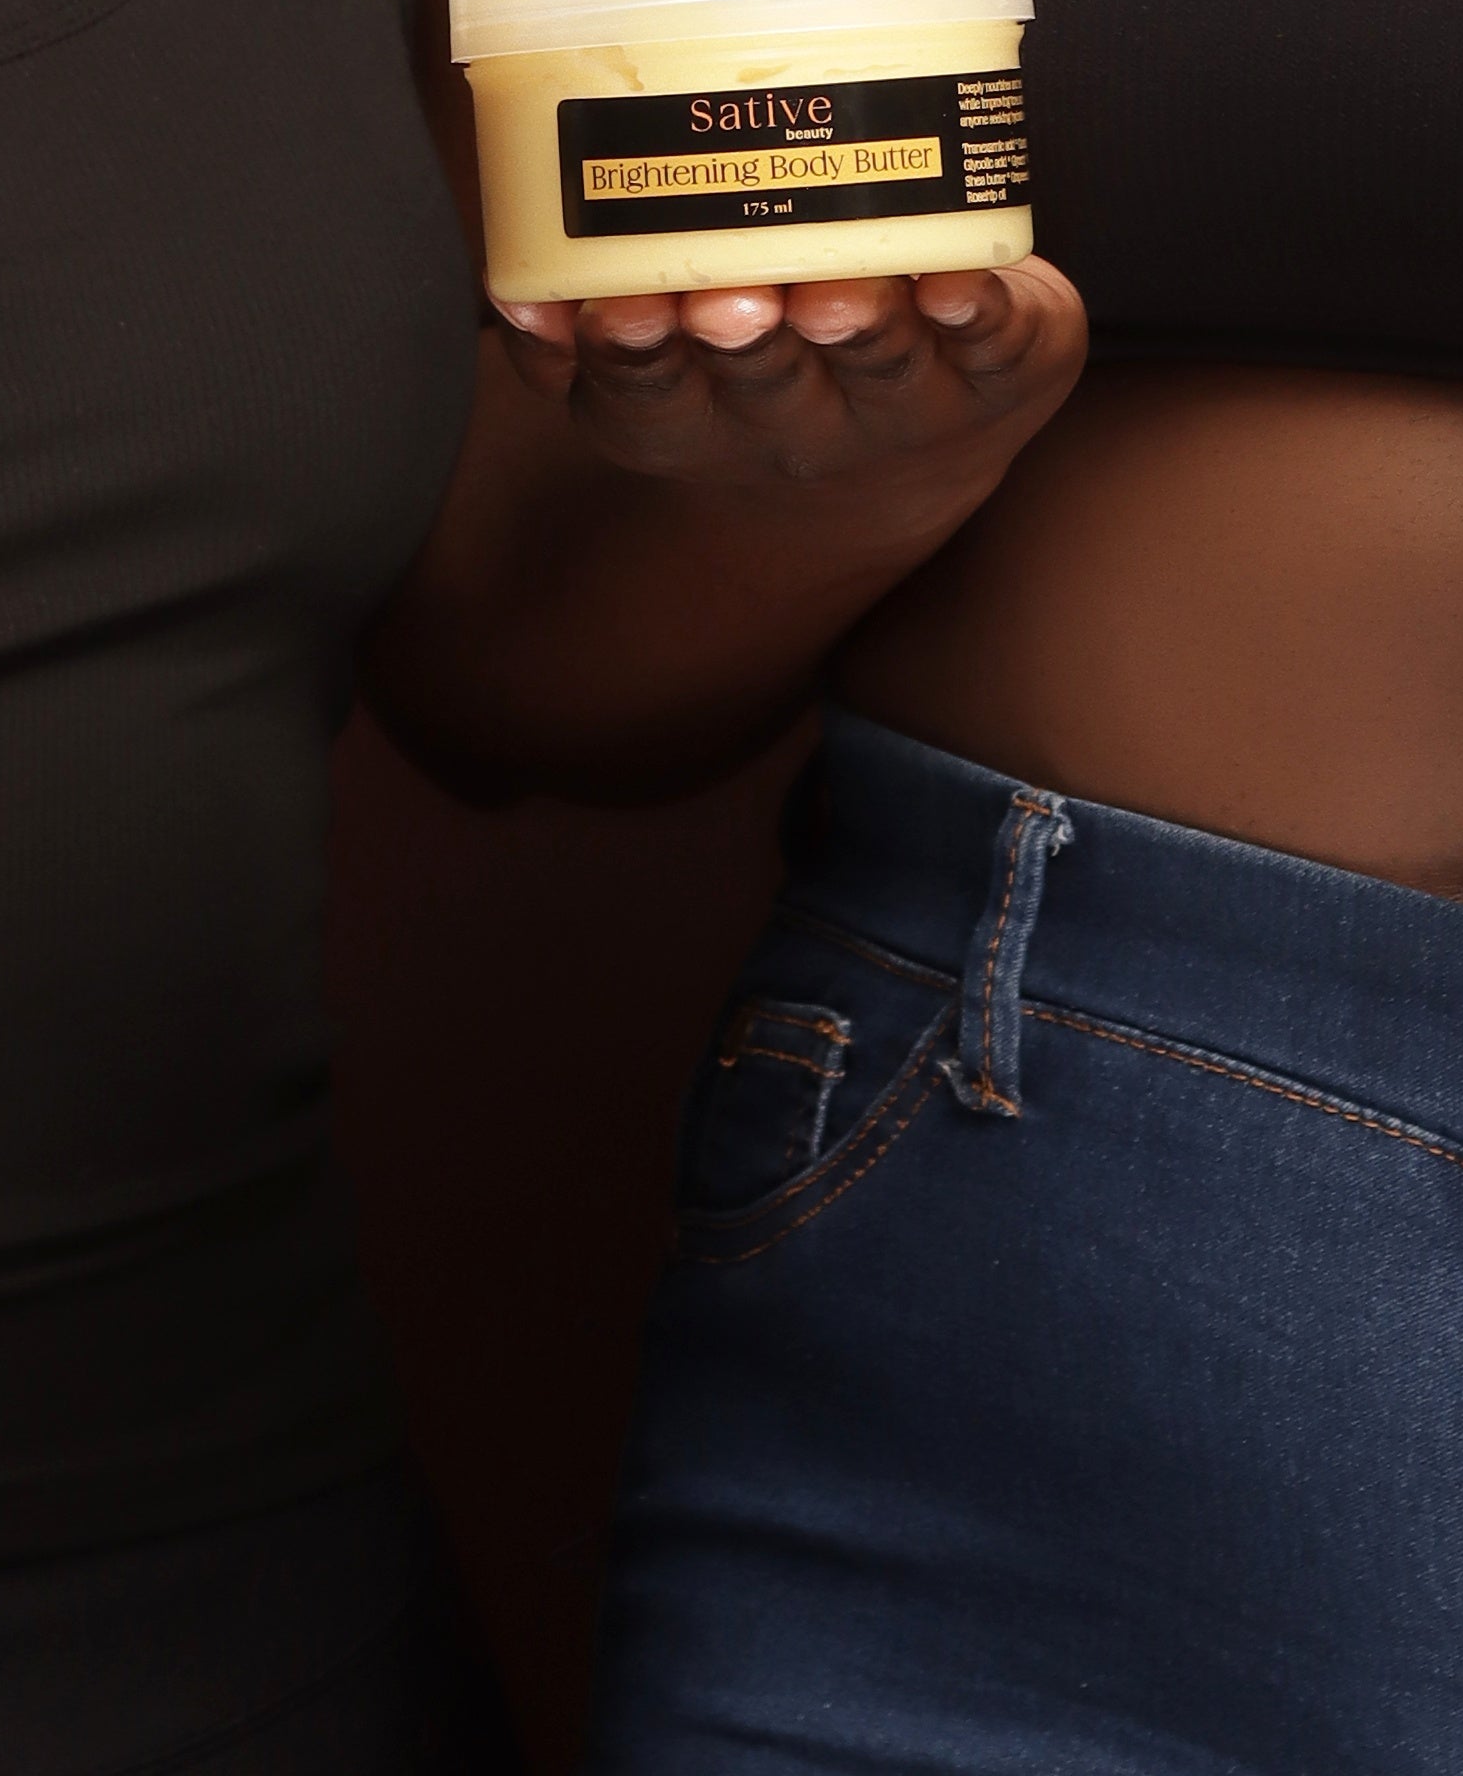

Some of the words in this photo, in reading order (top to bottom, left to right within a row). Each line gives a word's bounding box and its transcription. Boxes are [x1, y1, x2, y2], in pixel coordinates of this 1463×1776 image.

[691, 93, 833, 132] Sative
[785, 127, 834, 141] beauty
[592, 158, 761, 194] Brightening
[770, 150, 844, 181] Body
[854, 146, 933, 174] Butter
[743, 201, 769, 216] 175
[774, 199, 793, 214] ml
